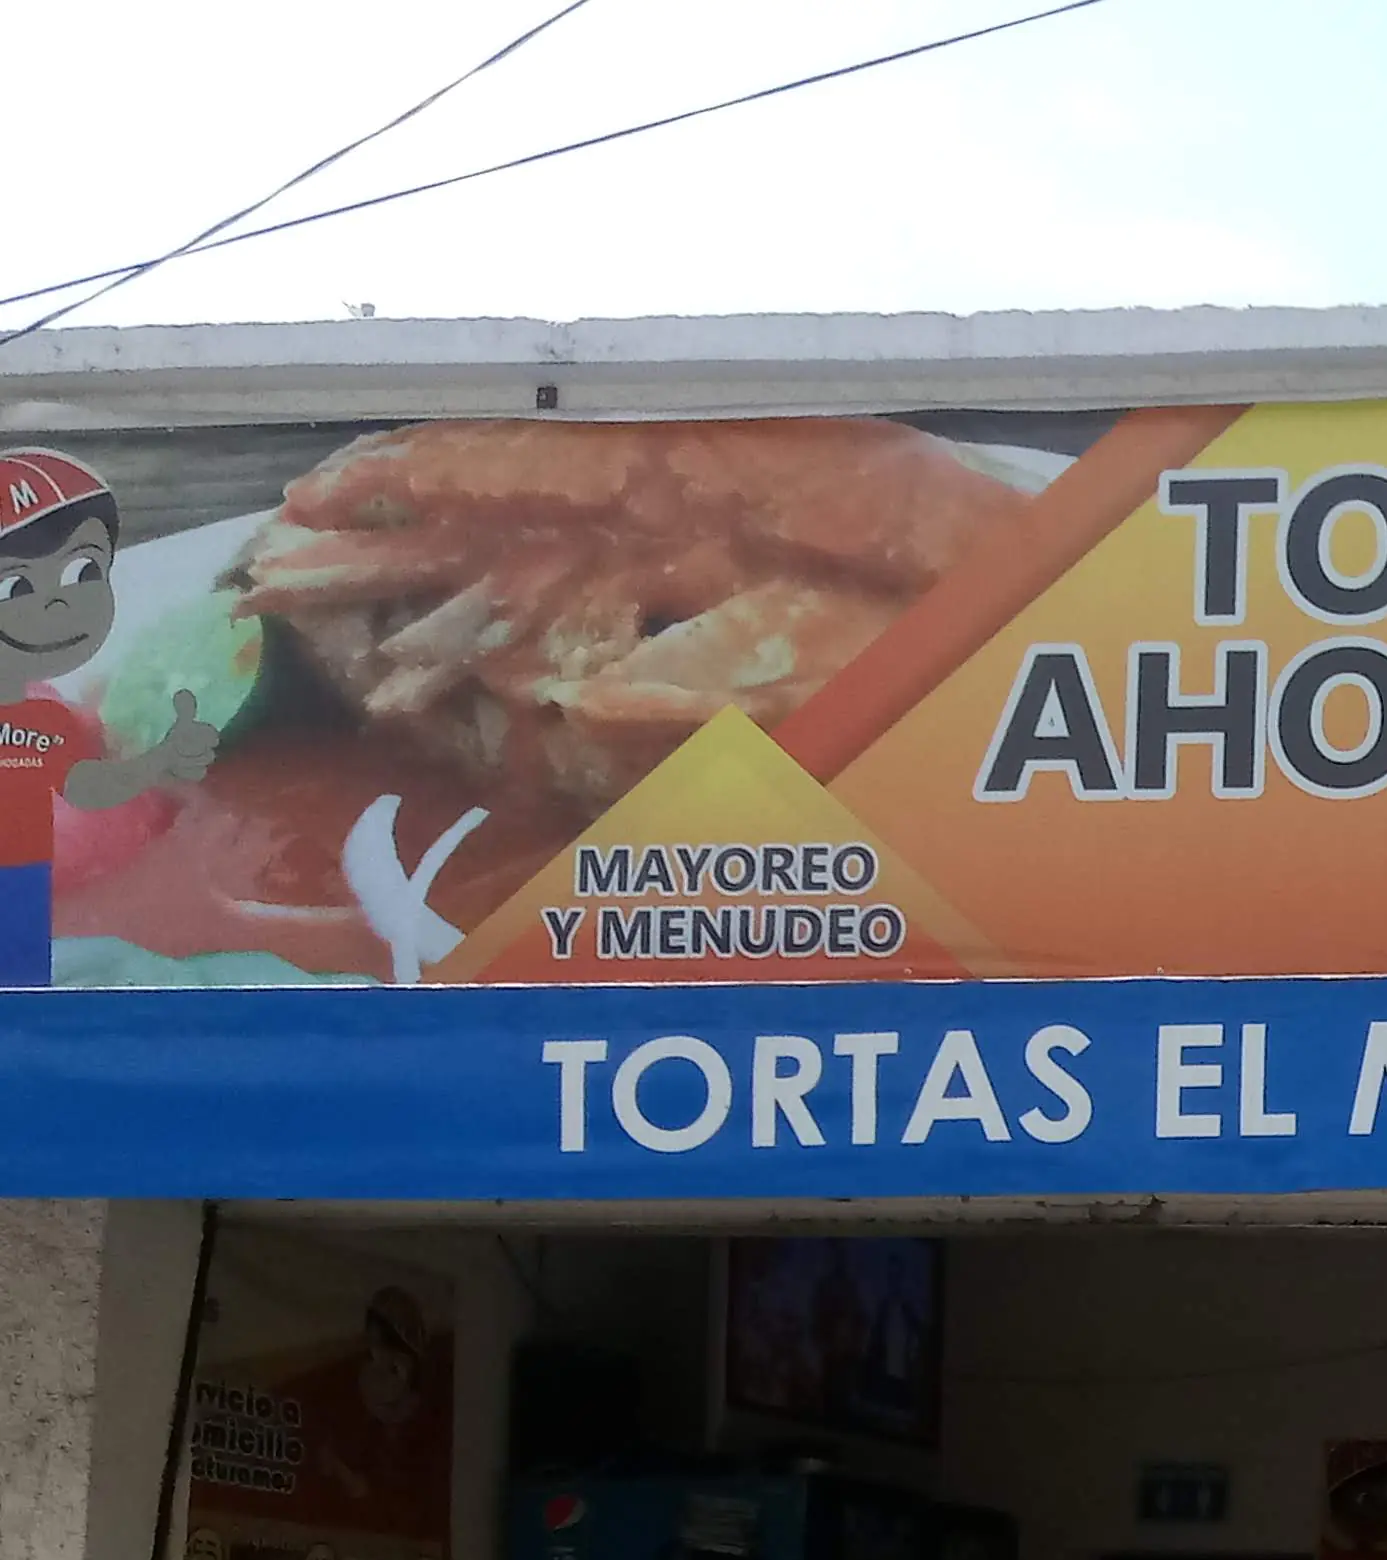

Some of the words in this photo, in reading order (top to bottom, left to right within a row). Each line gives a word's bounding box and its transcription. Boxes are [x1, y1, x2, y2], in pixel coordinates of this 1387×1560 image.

[575, 843, 879, 896] MAYOREO
[543, 907, 588, 960] Y
[599, 903, 906, 960] MENUDEO
[541, 1023, 1092, 1154] TORTAS
[1155, 1021, 1297, 1138] EL
